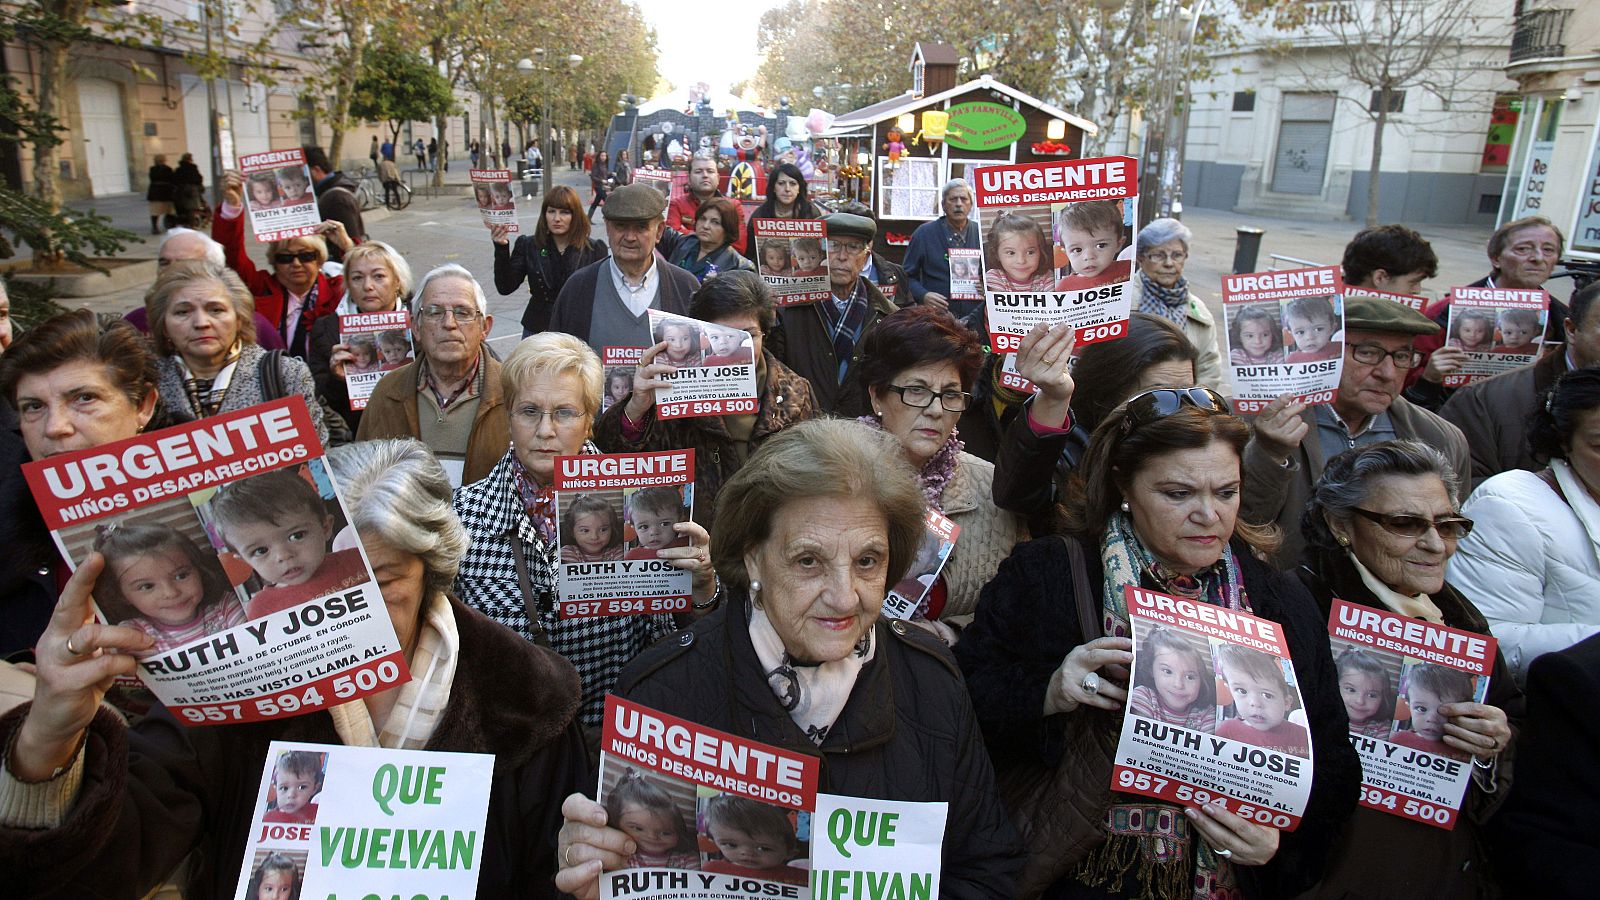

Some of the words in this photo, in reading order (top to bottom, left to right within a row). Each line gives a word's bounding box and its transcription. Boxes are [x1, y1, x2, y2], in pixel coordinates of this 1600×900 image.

[242, 150, 302, 166] URGENTE
[1532, 159, 1547, 175] Re
[982, 162, 1126, 192] URGENTE
[1528, 177, 1544, 192] ba
[984, 194, 1019, 205] NIÑOS
[1023, 187, 1126, 203] DESAPARECIDOS
[1521, 195, 1541, 212] jas
[255, 209, 279, 218] RUTH
[291, 204, 313, 213] JOSE
[757, 221, 822, 231] URGENTE
[1228, 270, 1334, 293] URGENTE
[994, 293, 1046, 307] RUTH
[1053, 294, 1066, 306] Y
[1073, 285, 1123, 305] JOSE
[1229, 293, 1256, 301] NIÑOS
[1258, 287, 1335, 299] DESAPARECIDOS
[1455, 289, 1543, 302] URGENTE
[1479, 301, 1544, 309] DESAPARECIDOS
[343, 313, 406, 326] URGENTE
[1075, 318, 1104, 328] LLAMA
[996, 336, 1020, 349] 95
[1083, 324, 1122, 341] 500
[607, 348, 644, 358] URGE
[350, 373, 376, 382] RUTH
[701, 369, 709, 377] Y
[714, 366, 749, 377] JOSE
[1237, 366, 1278, 377] RUTH
[1283, 366, 1293, 375] Y
[1299, 361, 1337, 375] JOSE
[1003, 374, 1030, 389] 957
[1445, 376, 1466, 384] 957
[353, 399, 369, 408] 95
[1304, 391, 1332, 404] 500
[661, 404, 688, 417] 957
[694, 402, 721, 414] 594
[726, 400, 754, 412] 500
[43, 406, 299, 500] URGENTE
[562, 454, 687, 477] URGENTE
[58, 492, 129, 522] NIÑOS
[132, 444, 308, 503] DESAPARECIDOS
[562, 480, 596, 489] NIÑOS
[599, 475, 687, 487] DESAPARECIDOS
[566, 563, 616, 576] RUTH
[622, 562, 634, 572] Y
[566, 602, 602, 616] 957
[608, 600, 645, 613] 594
[651, 598, 686, 611] 500
[887, 594, 909, 614] SE
[1134, 590, 1277, 642] URGENTE
[143, 633, 240, 676] RUTH
[246, 620, 269, 646] Y
[282, 589, 369, 635] JOSE
[1137, 607, 1175, 624] NIÑOS
[1178, 619, 1281, 654] DESAPARECIDOS
[1339, 605, 1487, 660] URGENTE
[155, 664, 232, 682] DESAPARECIERON
[270, 634, 312, 654] OCTUBRE
[316, 628, 329, 637] EN
[330, 613, 372, 632] CÓRDOBA
[1335, 627, 1373, 644] NIÑOS
[1377, 637, 1483, 672] DESAPARECIDOS
[174, 696, 185, 705] SI
[187, 692, 221, 704] LOS
[224, 685, 256, 701] HAS
[259, 673, 304, 694] VISTO
[307, 654, 360, 679] LLAMA
[364, 645, 387, 659] AL:
[182, 704, 243, 724] 957
[255, 686, 325, 716] 594
[332, 660, 400, 699] 500
[614, 704, 804, 790] URGENTE
[1134, 719, 1201, 751] RUTH
[1210, 737, 1226, 756] Y
[1233, 747, 1301, 778] JOSE
[1349, 735, 1377, 753] TH
[1384, 744, 1398, 758] Y
[1403, 751, 1461, 777] JOSE
[611, 738, 658, 767] NIÑOS
[660, 756, 804, 807] DESAPARECIDOS
[372, 763, 447, 817] QUE
[1139, 762, 1162, 773] LOS
[1165, 769, 1189, 781] HAS
[1191, 776, 1226, 792] VISTO
[1229, 788, 1270, 806] LLAMA
[1273, 801, 1294, 812] AL:
[1366, 776, 1395, 790] VISTO
[1398, 785, 1433, 801] LLAMA
[1434, 796, 1452, 806] AL:
[1118, 770, 1169, 794] 957
[1175, 785, 1228, 810] 594
[1236, 805, 1291, 828] 500
[1403, 800, 1450, 824] 500
[256, 825, 312, 844] JOSE
[827, 808, 900, 858] QUE
[320, 826, 477, 870] VUELVAN
[611, 871, 688, 898] RUTH
[697, 873, 716, 889] Y
[725, 878, 799, 898] JOSE
[812, 870, 932, 900] UELVAN
